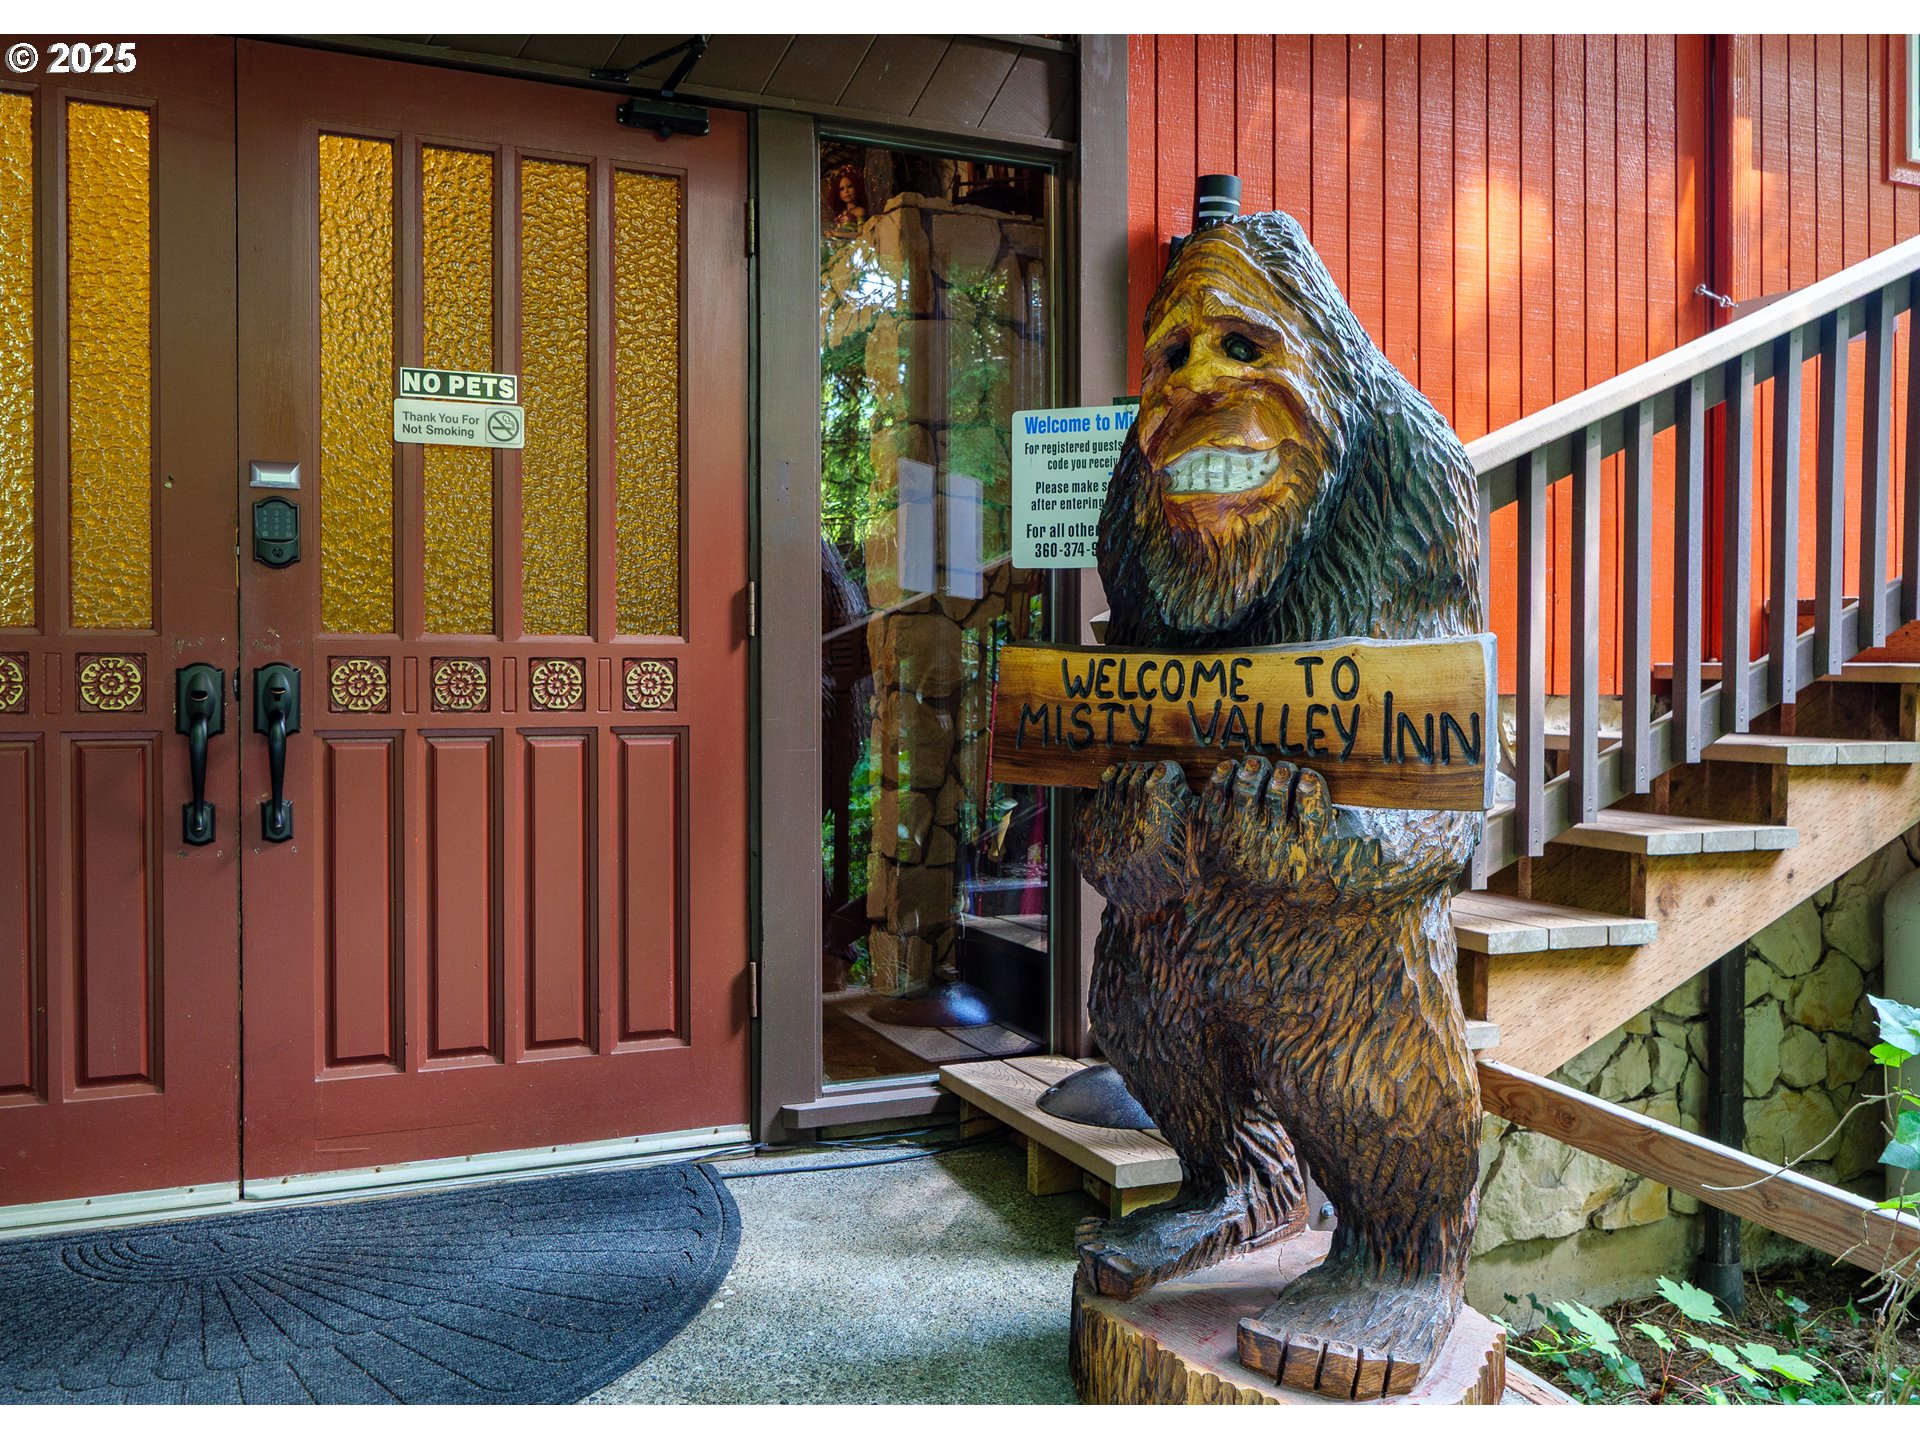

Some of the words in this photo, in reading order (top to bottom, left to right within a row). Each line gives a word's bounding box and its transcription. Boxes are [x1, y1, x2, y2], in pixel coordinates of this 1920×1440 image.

[403, 371, 441, 393] NO
[449, 375, 514, 399] PETS
[403, 411, 436, 423] Thank
[438, 413, 459, 424] You
[462, 415, 480, 425] For
[1025, 416, 1091, 434] Welcome
[1096, 414, 1110, 431] to
[1115, 411, 1136, 430] Mi
[403, 424, 422, 434] Not
[426, 425, 474, 439] Smoking
[1025, 443, 1039, 455] For
[1042, 440, 1089, 456] registered
[1093, 440, 1122, 454] guests
[1047, 458, 1069, 470] code
[1071, 459, 1087, 471] you
[1036, 481, 1069, 494] Please
[1072, 480, 1099, 493] make
[1031, 498, 1057, 511] after
[1060, 497, 1104, 511] entering
[1027, 524, 1046, 539] For
[1049, 523, 1065, 538] all
[1061, 657, 1252, 702] WELCOME
[1294, 655, 1360, 701] TO
[1015, 701, 1152, 750] MISTY
[1187, 699, 1360, 763] VALLEY
[1383, 691, 1481, 765] INN
